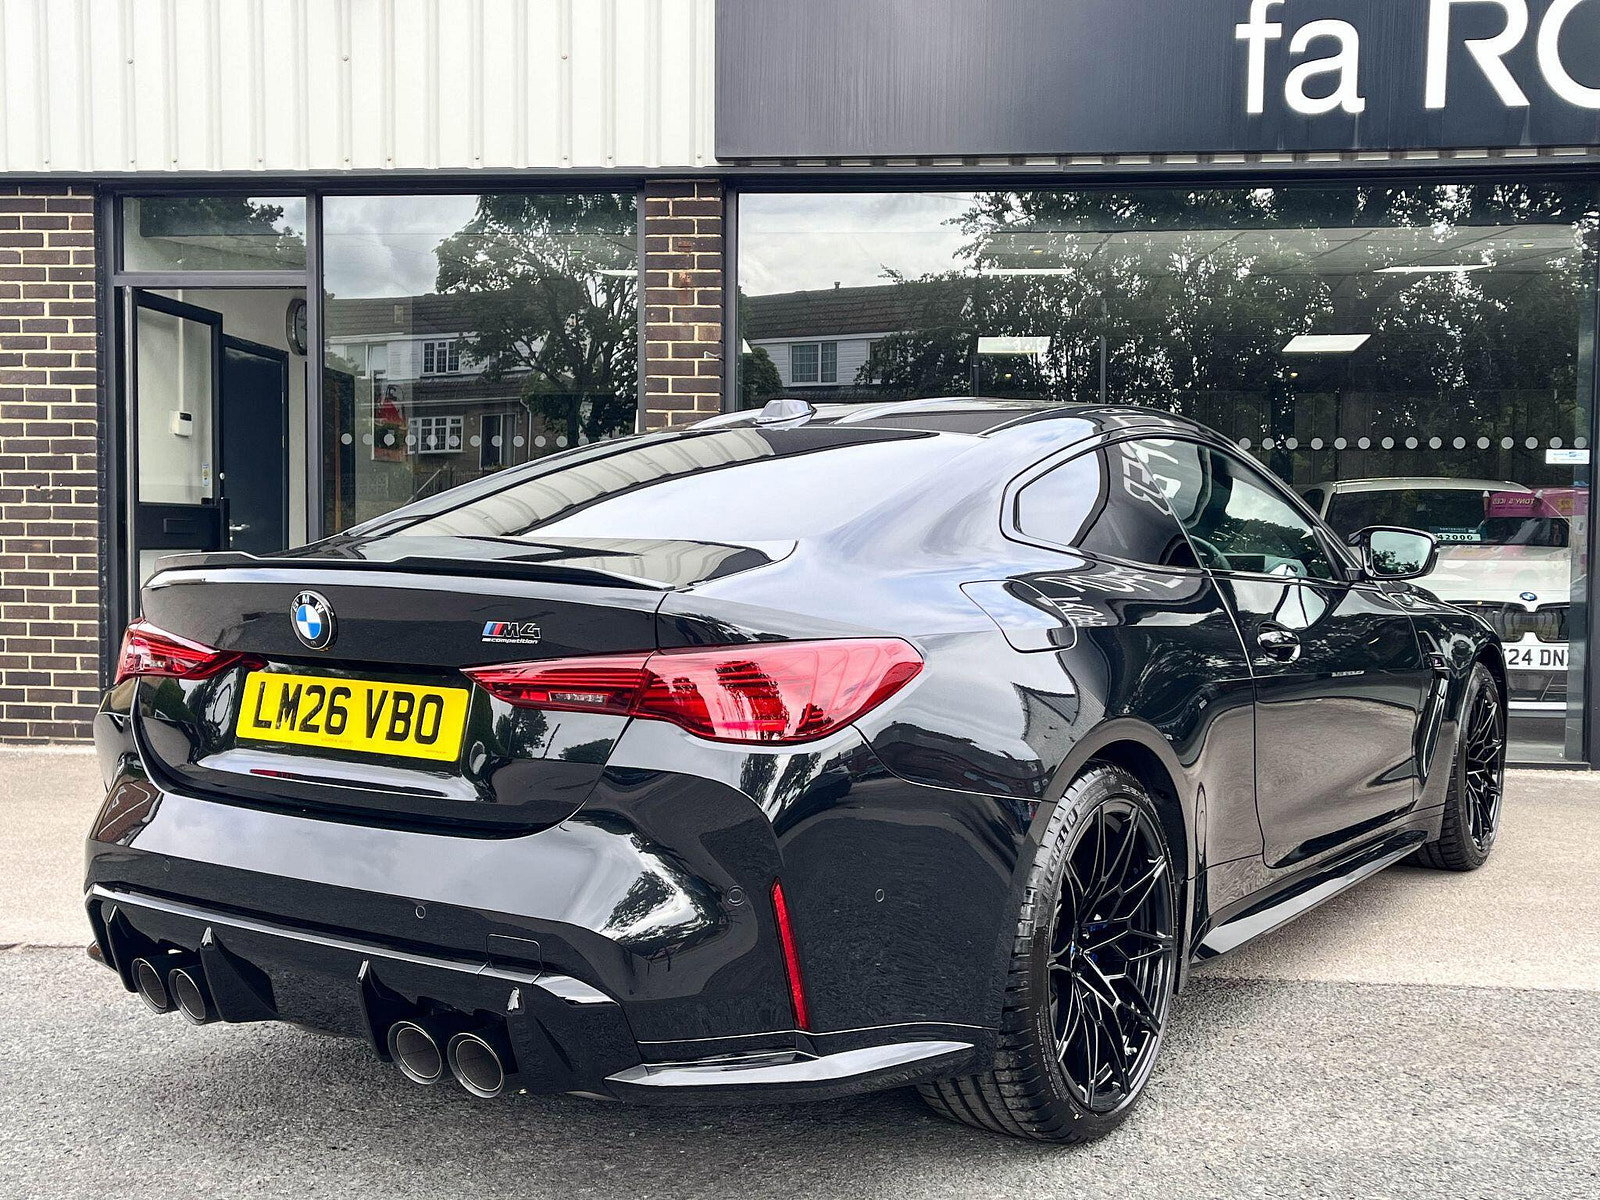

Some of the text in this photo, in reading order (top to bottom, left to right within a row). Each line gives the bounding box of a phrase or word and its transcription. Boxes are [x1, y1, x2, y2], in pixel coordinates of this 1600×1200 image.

[1235, 0, 1365, 114] fa
[292, 594, 325, 613] BMW
[490, 621, 541, 639] M4
[491, 637, 538, 645] competition
[1502, 648, 1569, 667] 24 DN
[252, 681, 445, 745] LM26 VBO
